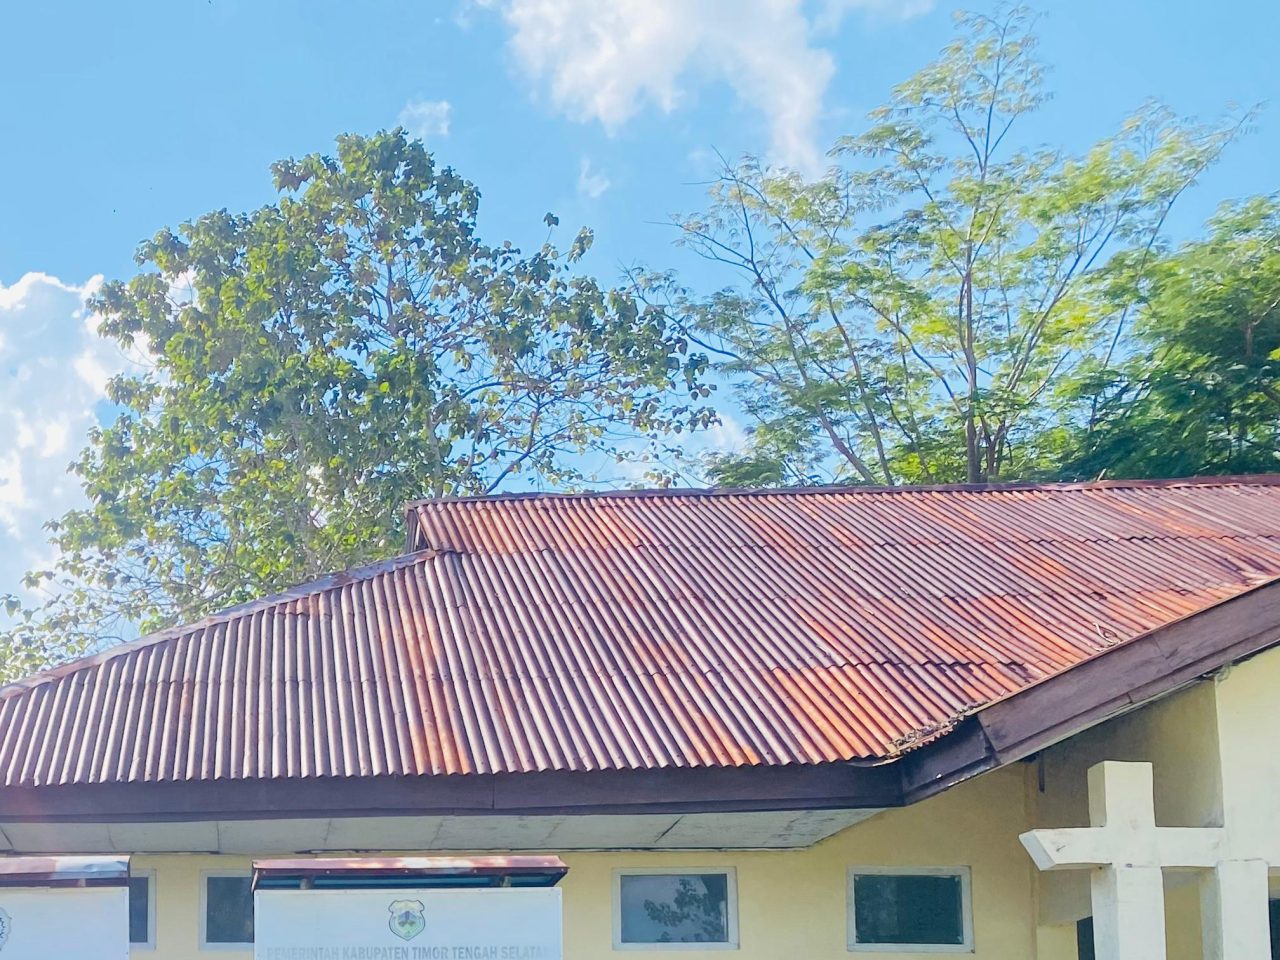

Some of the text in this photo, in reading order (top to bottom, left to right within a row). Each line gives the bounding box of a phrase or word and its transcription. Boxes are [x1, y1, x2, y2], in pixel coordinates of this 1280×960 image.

[342, 946, 409, 960] KABUPATEN
[412, 945, 449, 960] TIMOR
[452, 945, 497, 960] TENGAH
